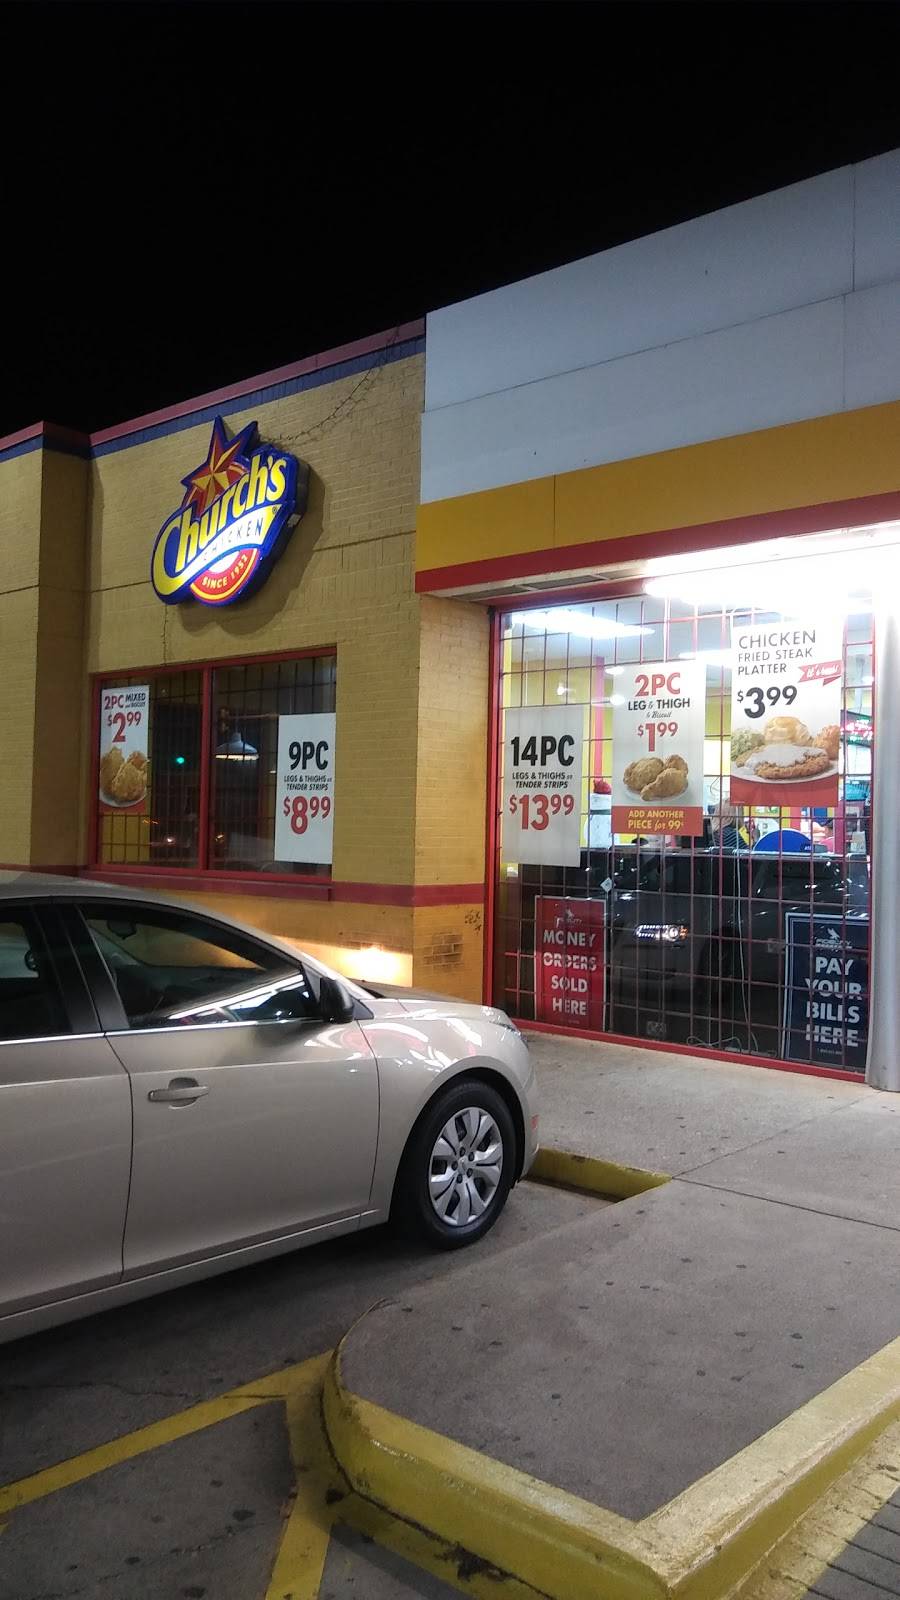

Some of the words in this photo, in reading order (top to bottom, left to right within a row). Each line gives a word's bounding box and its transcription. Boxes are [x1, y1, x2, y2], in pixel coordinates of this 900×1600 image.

[153, 454, 286, 595] Church's
[202, 575, 228, 589] SINCE
[230, 554, 248, 579] 1952
[738, 629, 816, 650] CHICKEN
[738, 651, 770, 663] FRIED
[775, 647, 813, 660] STEAK
[738, 662, 787, 676] PLATTER
[635, 672, 681, 697] 2PC
[104, 695, 124, 710] 2PC
[125, 693, 146, 702] MIXED
[628, 700, 646, 711] LEG
[656, 698, 690, 710] THIGH
[288, 740, 329, 771] 9PC
[511, 734, 575, 767] 14PC
[284, 775, 298, 783] LEGS
[299, 775, 303, 783] &
[304, 775, 327, 783] THIGHS
[512, 772, 529, 780] LEGS
[531, 772, 536, 780] &
[538, 772, 566, 780] THIGHS
[515, 781, 542, 789] TENDER
[543, 781, 568, 789] STRIPS
[309, 783, 329, 791] STRIPS
[628, 810, 646, 818] ADD
[647, 810, 684, 819] ANOTHER
[628, 820, 652, 829] PIECE
[543, 929, 597, 947] MONEY
[543, 952, 598, 972] ORDERS
[815, 956, 854, 976] PAY
[551, 974, 588, 993] SOLD
[805, 977, 863, 1000] YOUR
[552, 997, 587, 1016] HERE
[806, 1001, 860, 1023] BILLS
[805, 1023, 859, 1047] HERE
